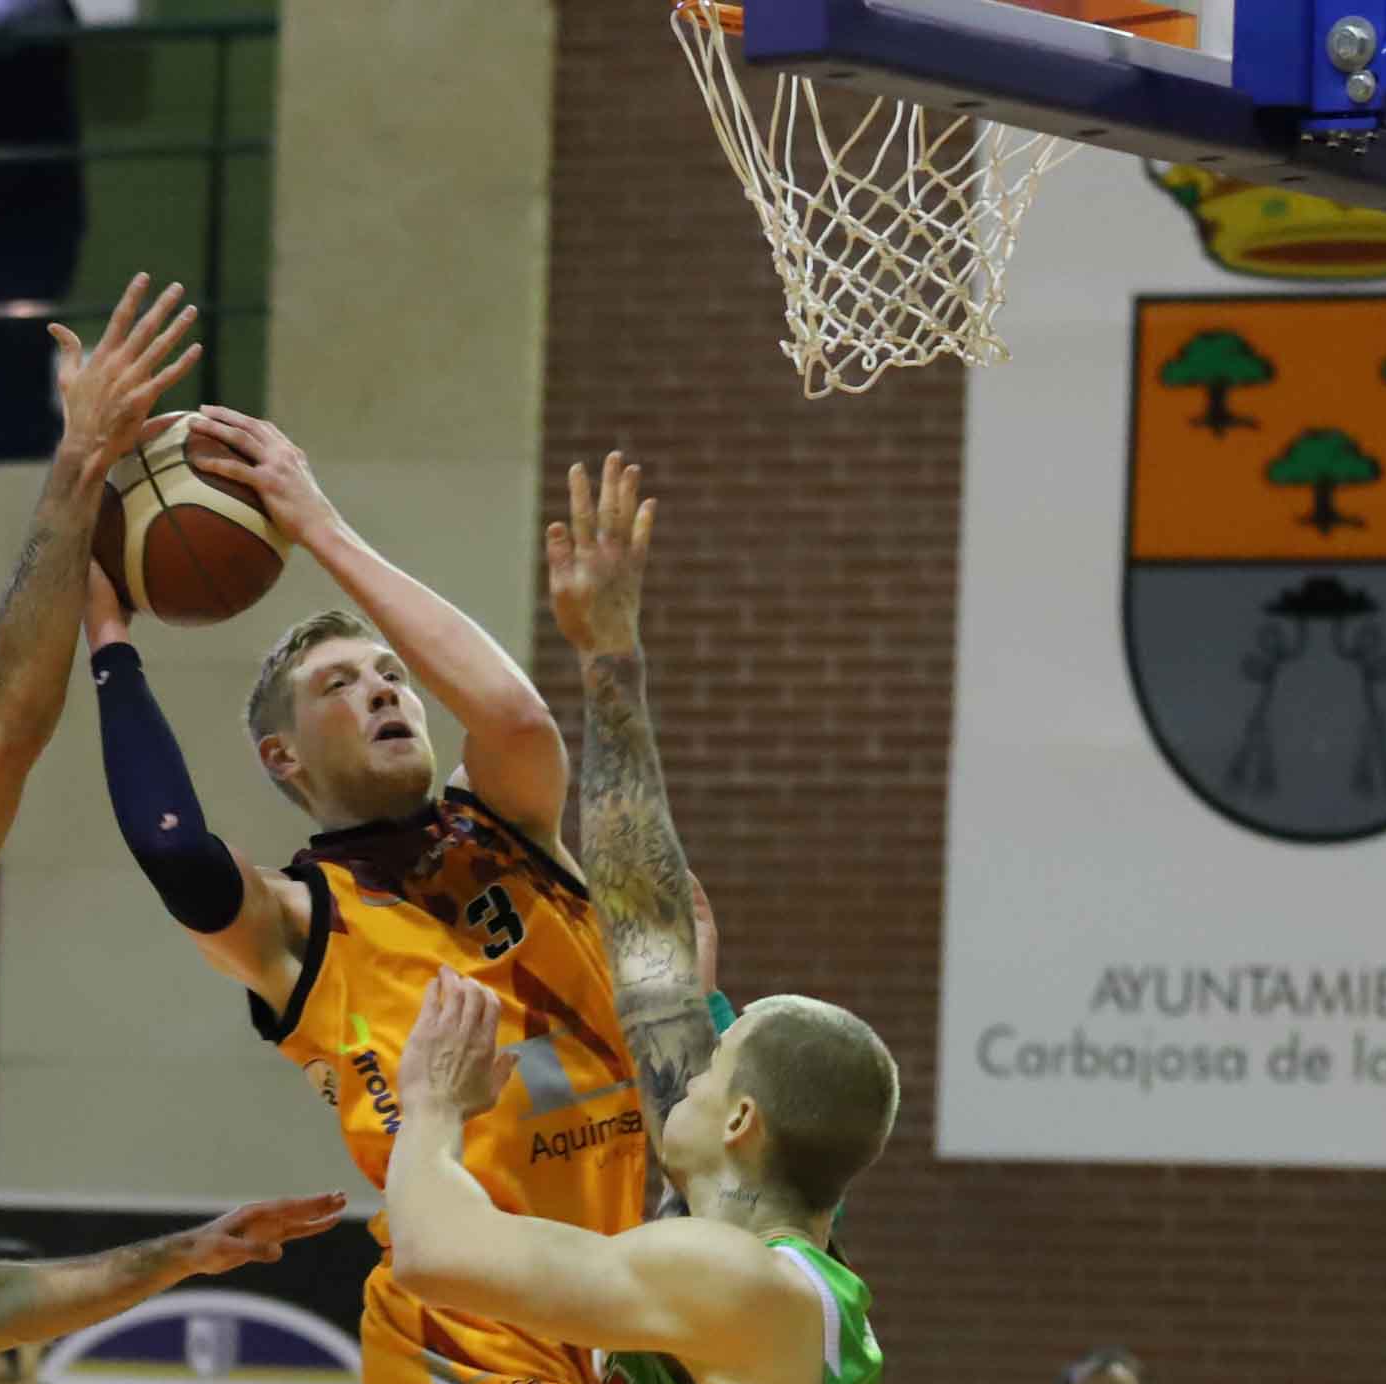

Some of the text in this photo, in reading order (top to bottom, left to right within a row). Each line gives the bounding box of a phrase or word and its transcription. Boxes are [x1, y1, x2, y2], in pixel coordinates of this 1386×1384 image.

[466, 882, 525, 962] 3
[975, 1025, 1249, 1092] Carbajosa
[1266, 1033, 1331, 1084] de
